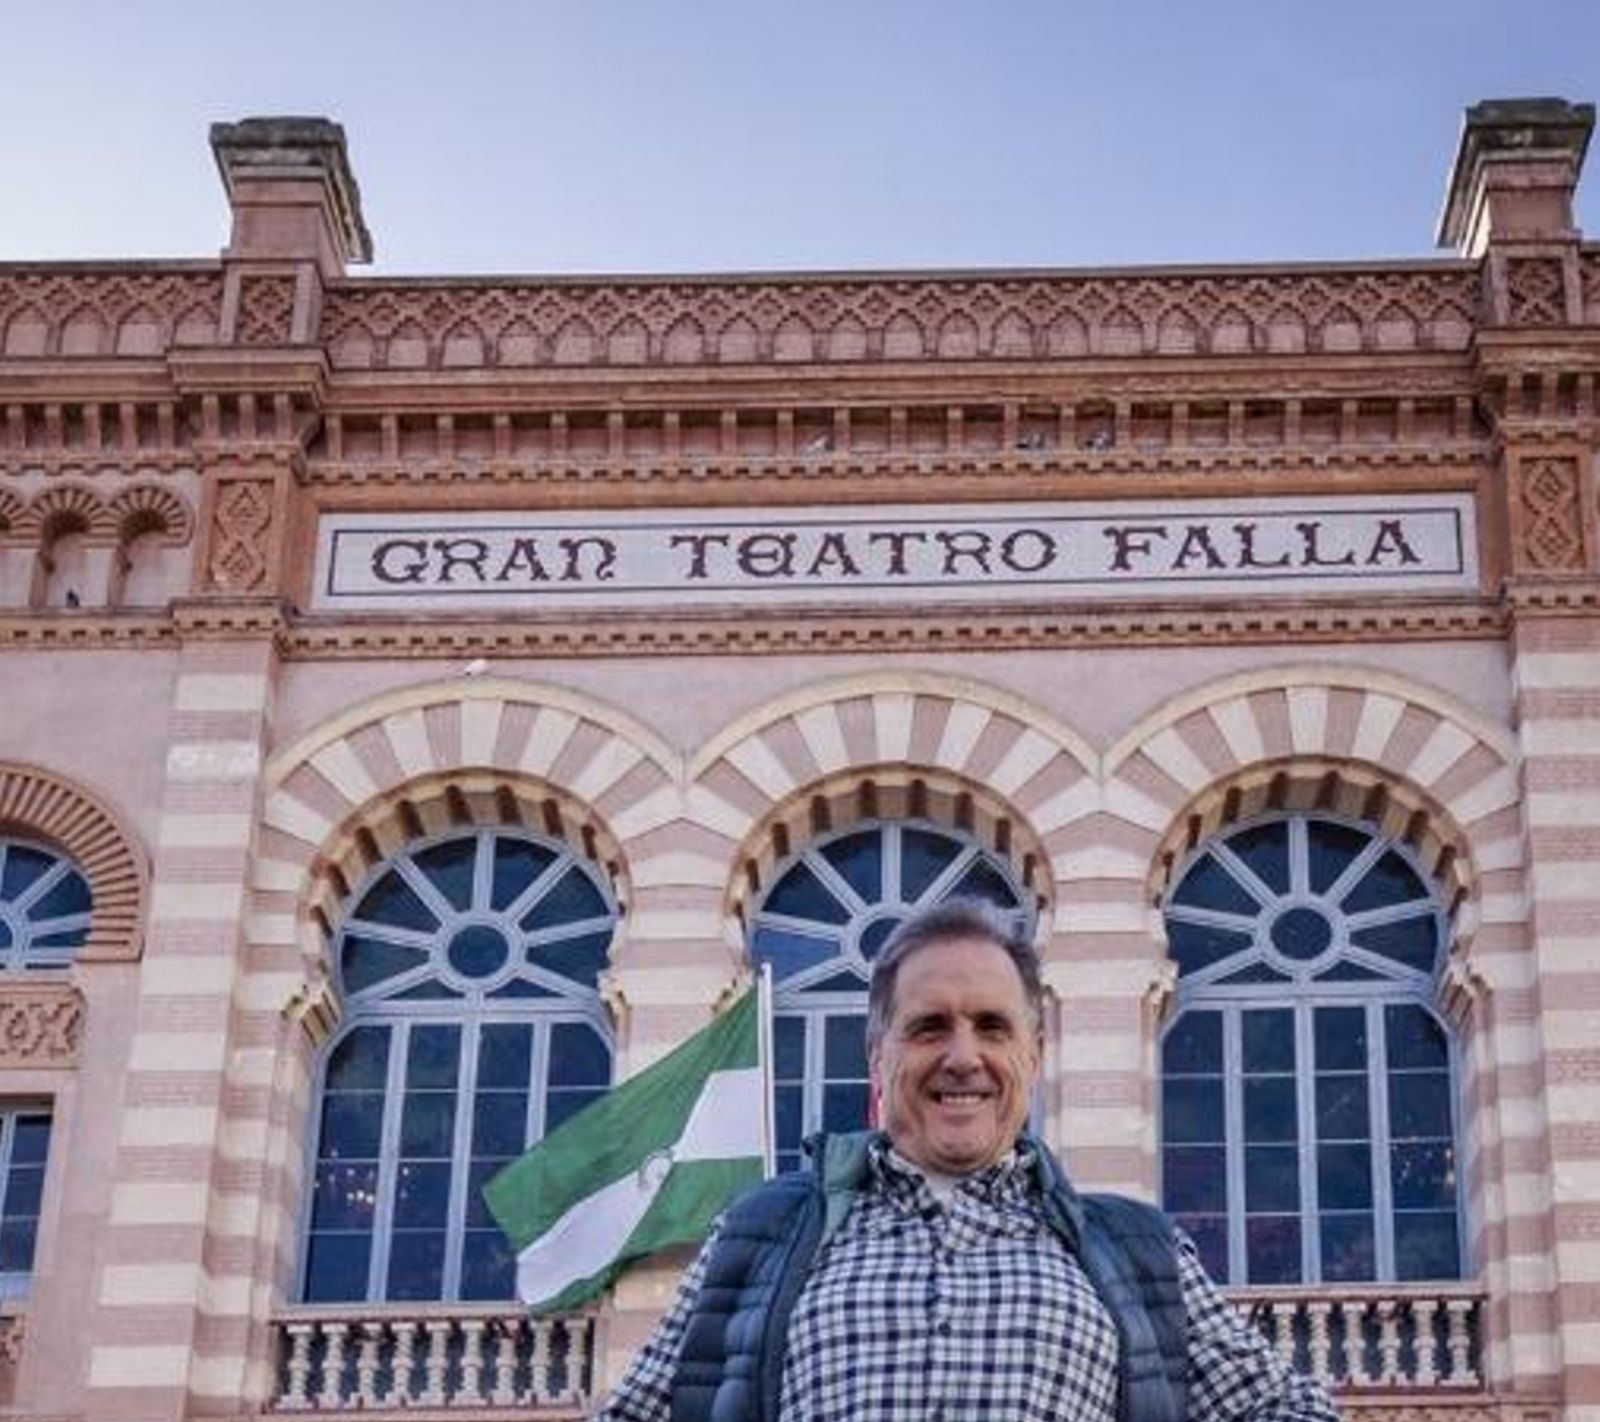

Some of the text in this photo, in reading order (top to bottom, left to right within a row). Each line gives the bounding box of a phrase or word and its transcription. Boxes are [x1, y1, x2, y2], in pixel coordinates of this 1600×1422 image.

[371, 519, 1422, 583] GRAN TEATRO FALLA
